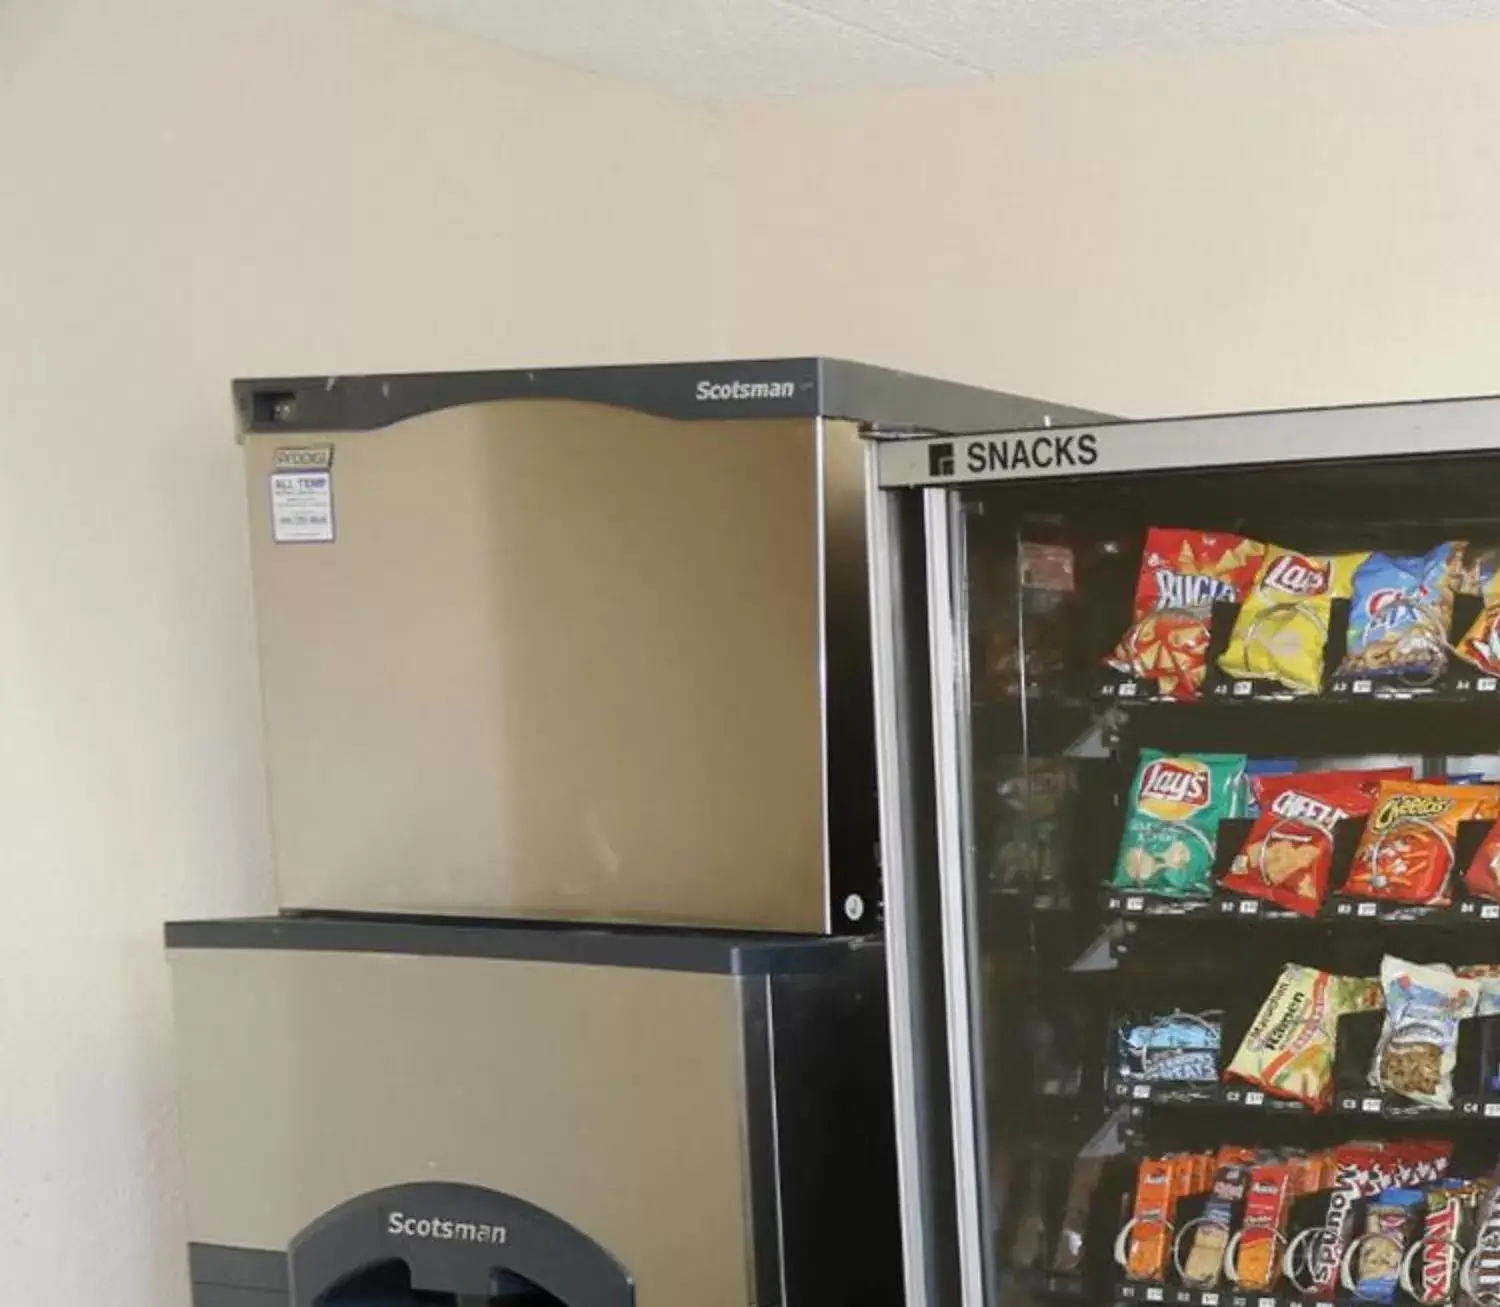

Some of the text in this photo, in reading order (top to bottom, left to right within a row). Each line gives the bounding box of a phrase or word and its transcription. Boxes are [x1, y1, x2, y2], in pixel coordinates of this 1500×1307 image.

[696, 379, 794, 400] Scotsman
[967, 434, 1098, 473] SNACKS
[1141, 762, 1207, 802] Lay's
[1375, 794, 1453, 829] Cheetos
[1265, 991, 1305, 1052] Ramen
[388, 1211, 507, 1244] Scotsman
[1422, 1197, 1460, 1304] TWIX
